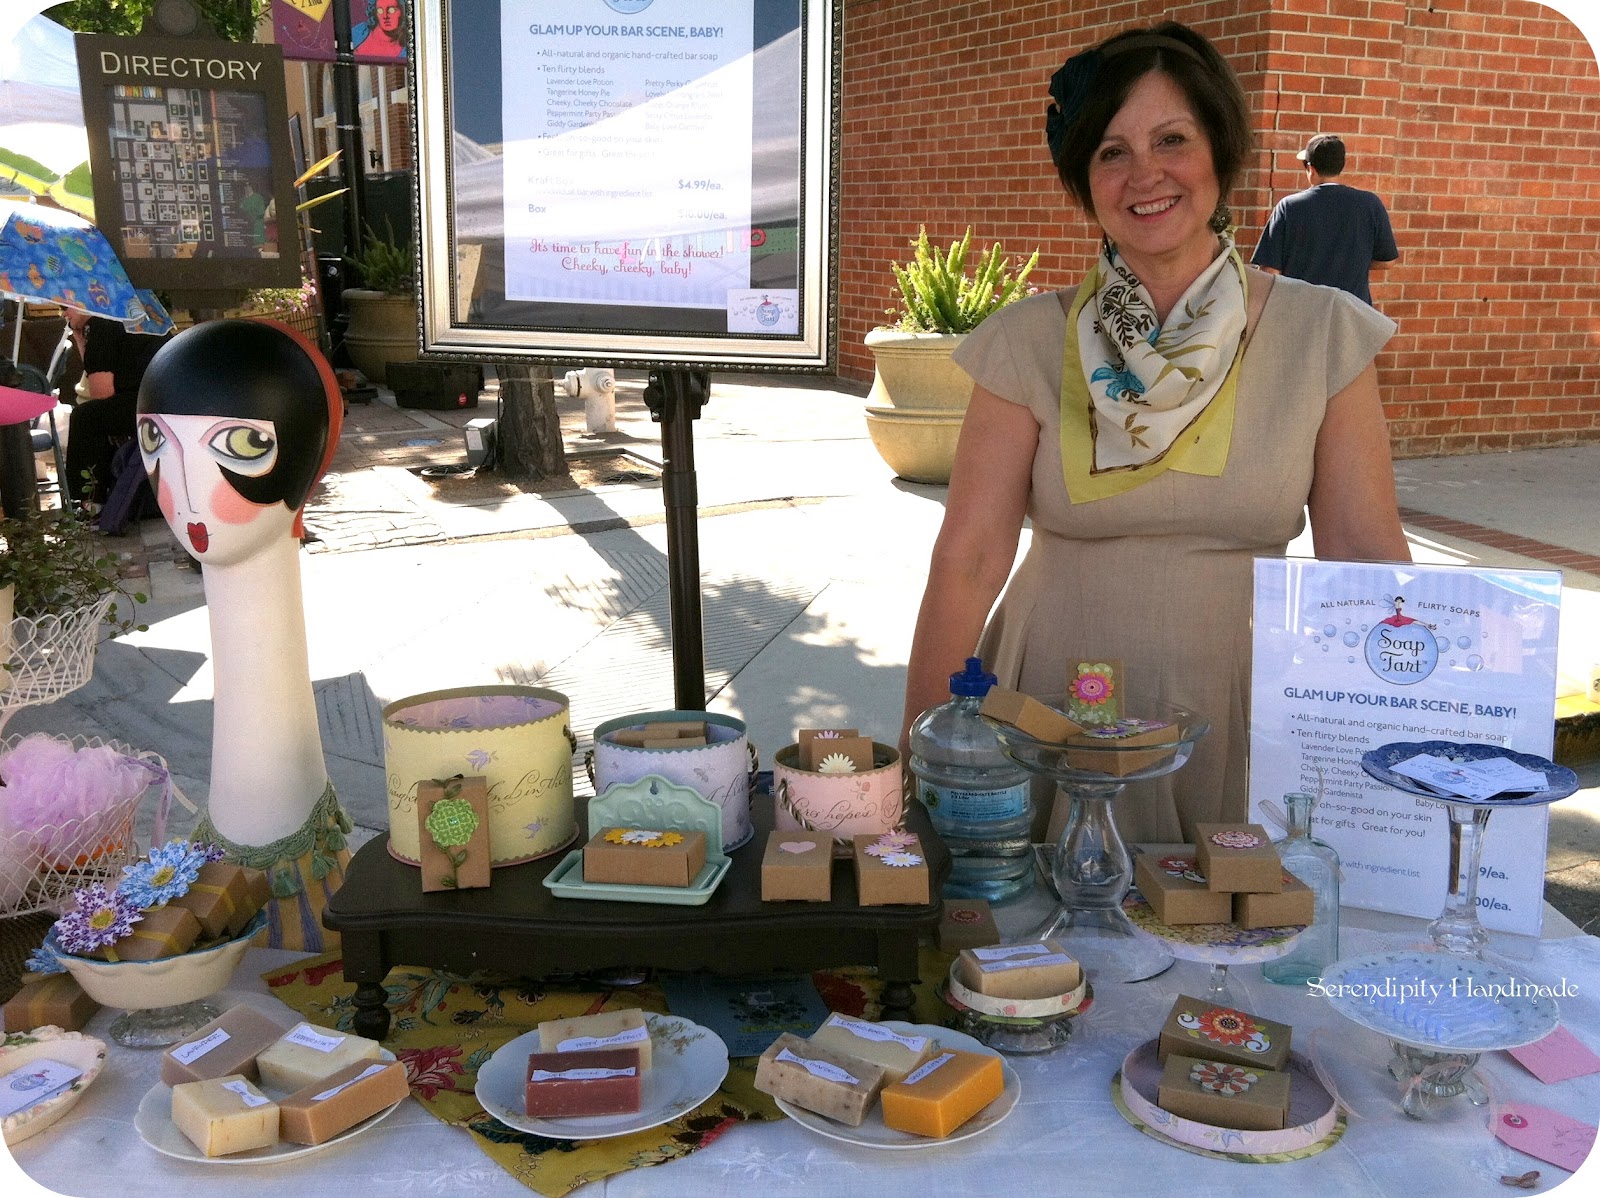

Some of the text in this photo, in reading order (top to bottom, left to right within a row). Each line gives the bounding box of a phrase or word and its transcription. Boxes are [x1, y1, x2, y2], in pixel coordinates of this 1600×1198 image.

[530, 24, 724, 38] GLAM UP YOUR BAR SCENE, BABY!
[542, 50, 584, 58] All-natural
[602, 52, 630, 60] organic
[700, 54, 718, 62] soap
[100, 51, 262, 80] DIRECTORY
[542, 64, 556, 72] Ten
[558, 64, 577, 74] flirty
[678, 179, 724, 190] $4.99/ea.
[528, 204, 546, 213] Box
[530, 238, 548, 253] It's
[552, 242, 578, 254] time
[580, 244, 590, 253] to
[594, 241, 620, 254] have
[622, 241, 642, 258] fun
[662, 244, 680, 256] the
[682, 244, 724, 258] shower!
[562, 256, 692, 278] Cheeky, cheeky, baby!
[1418, 602, 1480, 618] FLIRTY SOAPS
[1378, 628, 1425, 657] Soap
[1284, 687, 1516, 719] GLAM UP YOUR BAR SCENE, BABY!
[1297, 714, 1346, 726] All-natural
[1348, 720, 1364, 728] and
[1366, 722, 1400, 732] organic
[1402, 724, 1464, 738] hand-crafted
[1486, 734, 1508, 744] soap
[1297, 729, 1370, 744] Ten flirty blends
[1301, 742, 1335, 752] Lavender
[1336, 746, 1354, 754] Love
[1301, 753, 1361, 768] Tangerine Honey
[1331, 766, 1360, 778] Cheeky
[1344, 780, 1364, 789] Party
[1324, 788, 1363, 798] Gardenista
[1415, 799, 1434, 810] Baby
[1320, 802, 1374, 814] oh-so-good
[1391, 811, 1412, 820] your
[1414, 813, 1432, 822] skin
[1321, 816, 1334, 826] for
[1336, 818, 1356, 828] gifts
[1362, 822, 1388, 833] Great
[1390, 826, 1403, 834] for
[1405, 828, 1426, 838] you!
[1346, 861, 1363, 870] with
[1364, 864, 1406, 876] ingredient
[1408, 868, 1420, 878] list
[1480, 866, 1508, 880] 9/ea.
[1475, 897, 1512, 911] 00/ea.
